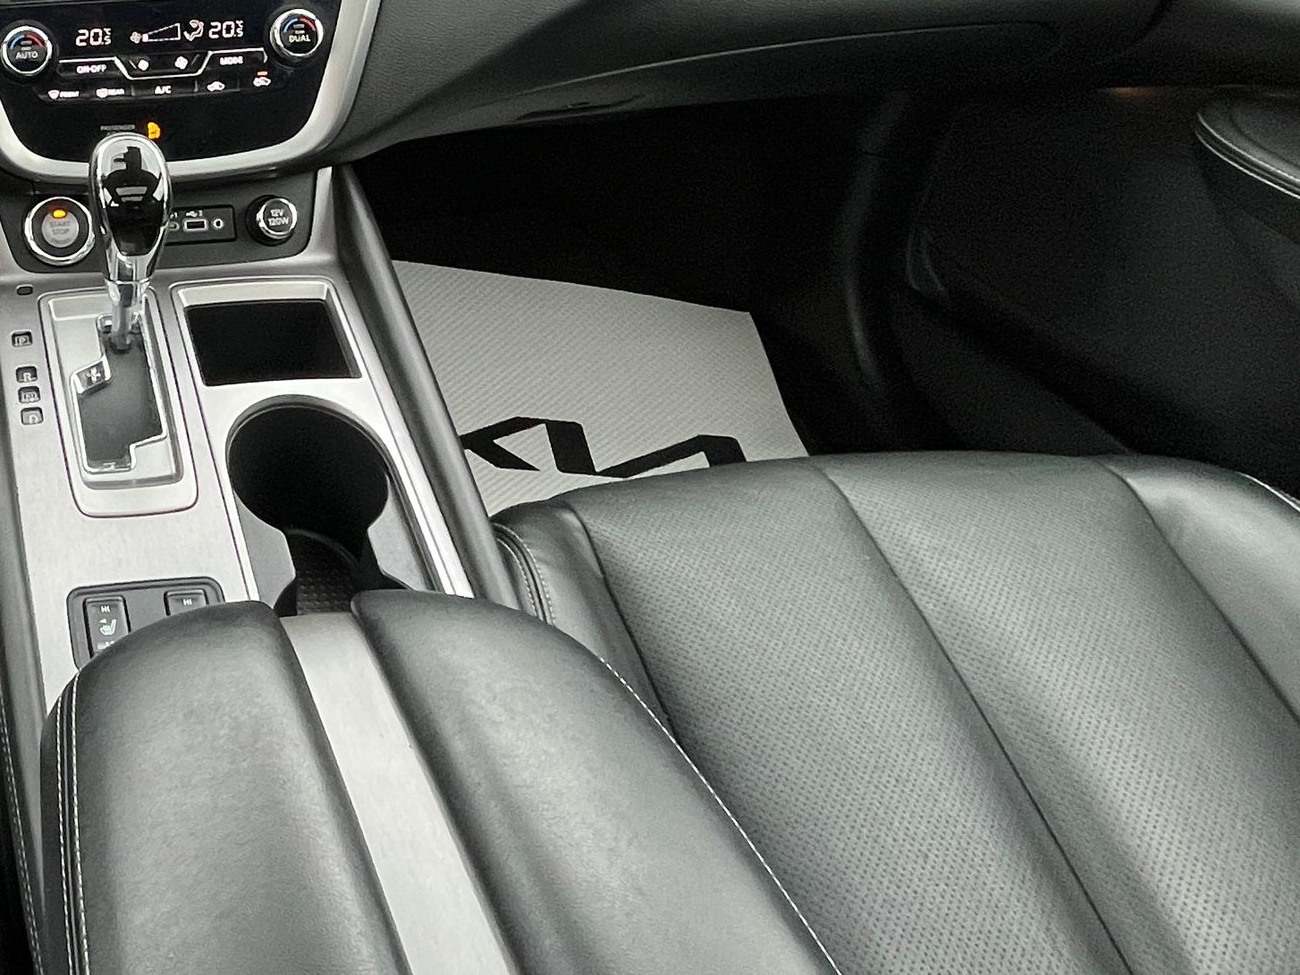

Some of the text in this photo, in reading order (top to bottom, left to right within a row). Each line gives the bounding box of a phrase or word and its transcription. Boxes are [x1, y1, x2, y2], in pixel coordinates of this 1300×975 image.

[288, 33, 311, 43] DUAL
[15, 50, 39, 60] AUTO
[219, 56, 243, 65] MODE
[154, 85, 172, 95] A/C
[270, 209, 284, 217] 12V
[267, 216, 290, 226] 120W
